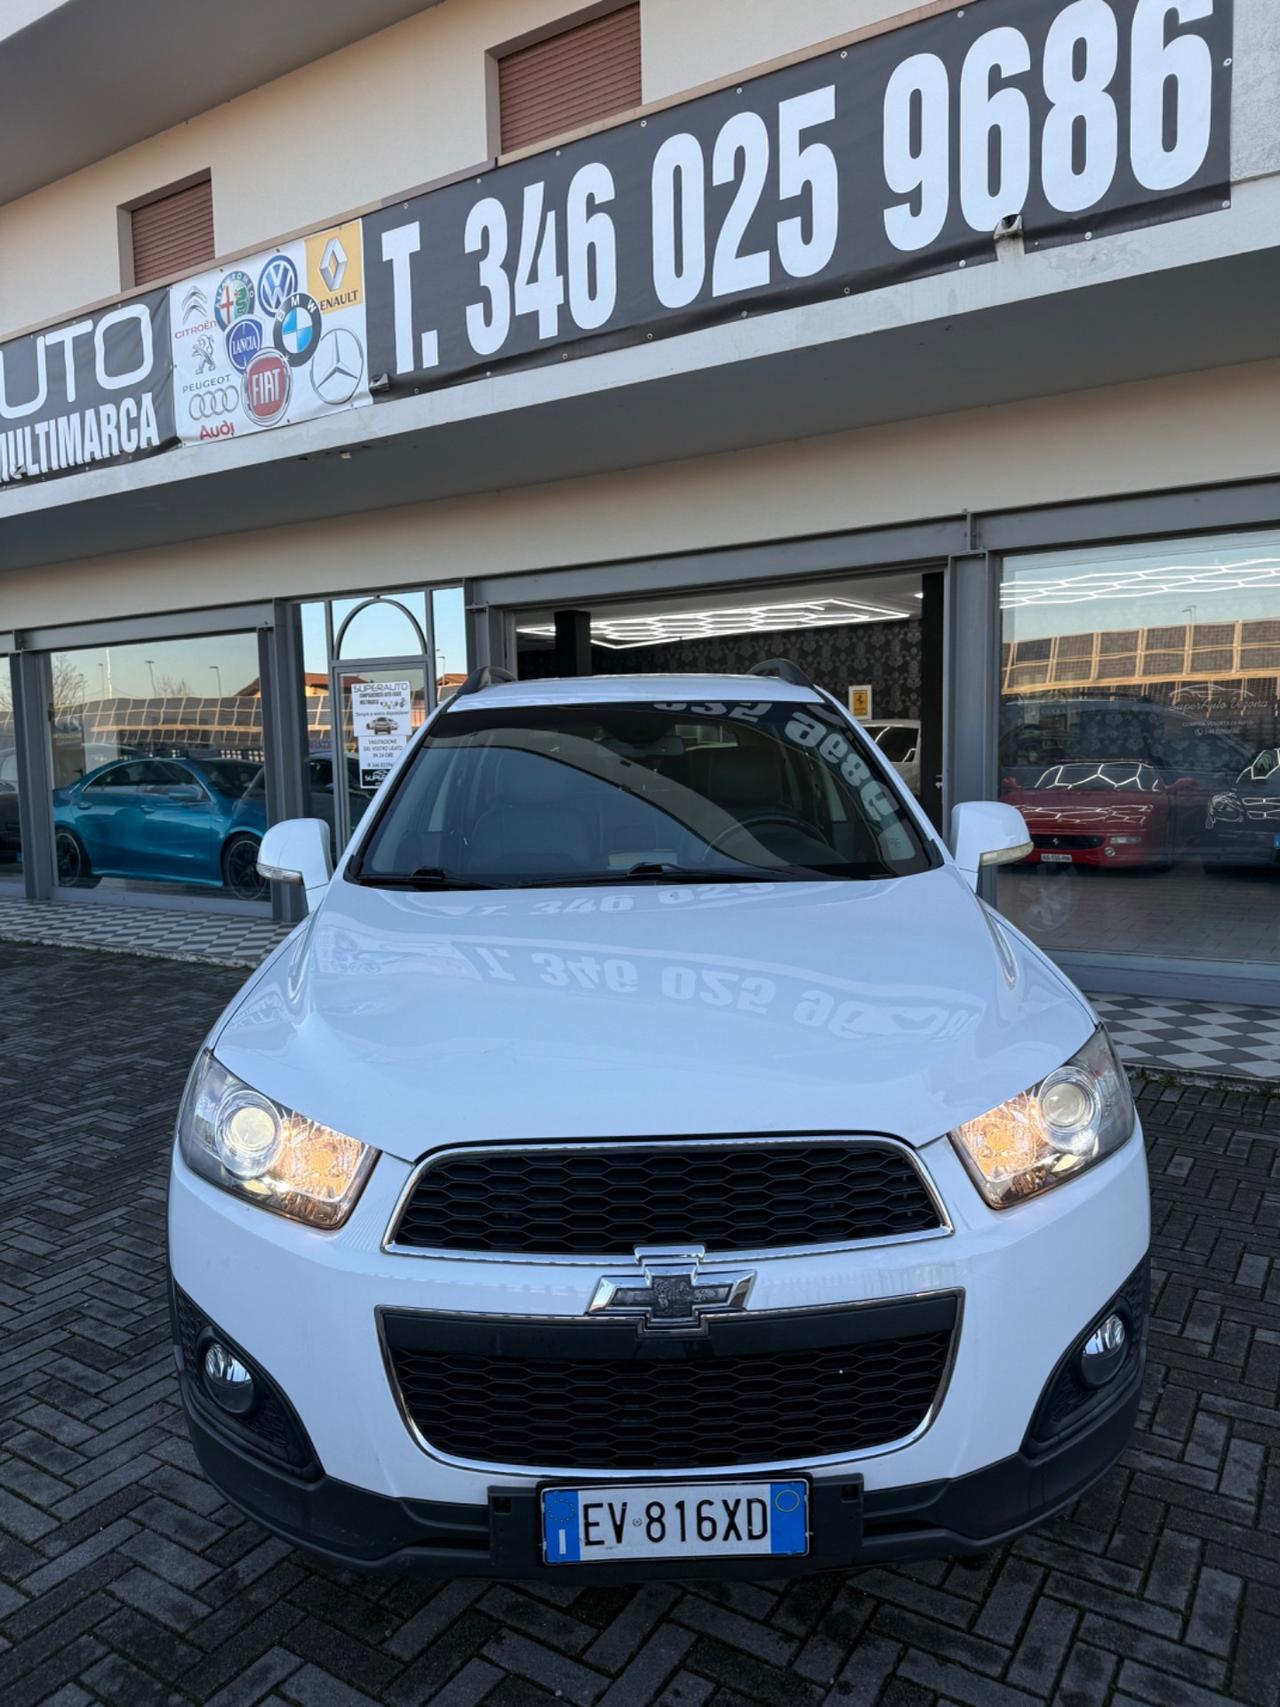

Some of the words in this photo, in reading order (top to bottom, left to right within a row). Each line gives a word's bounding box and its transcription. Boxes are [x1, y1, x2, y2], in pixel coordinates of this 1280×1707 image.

[381, 220, 439, 374] T.
[465, 163, 617, 355] 346
[652, 85, 839, 309] 025
[884, 0, 1214, 251] 9686
[318, 289, 359, 312] ENAULT
[182, 374, 231, 394] PEUGEOT
[251, 368, 281, 407] FIAT
[200, 420, 235, 440] Audi
[582, 1501, 628, 1546] EV
[644, 1497, 769, 1543] 816XD
